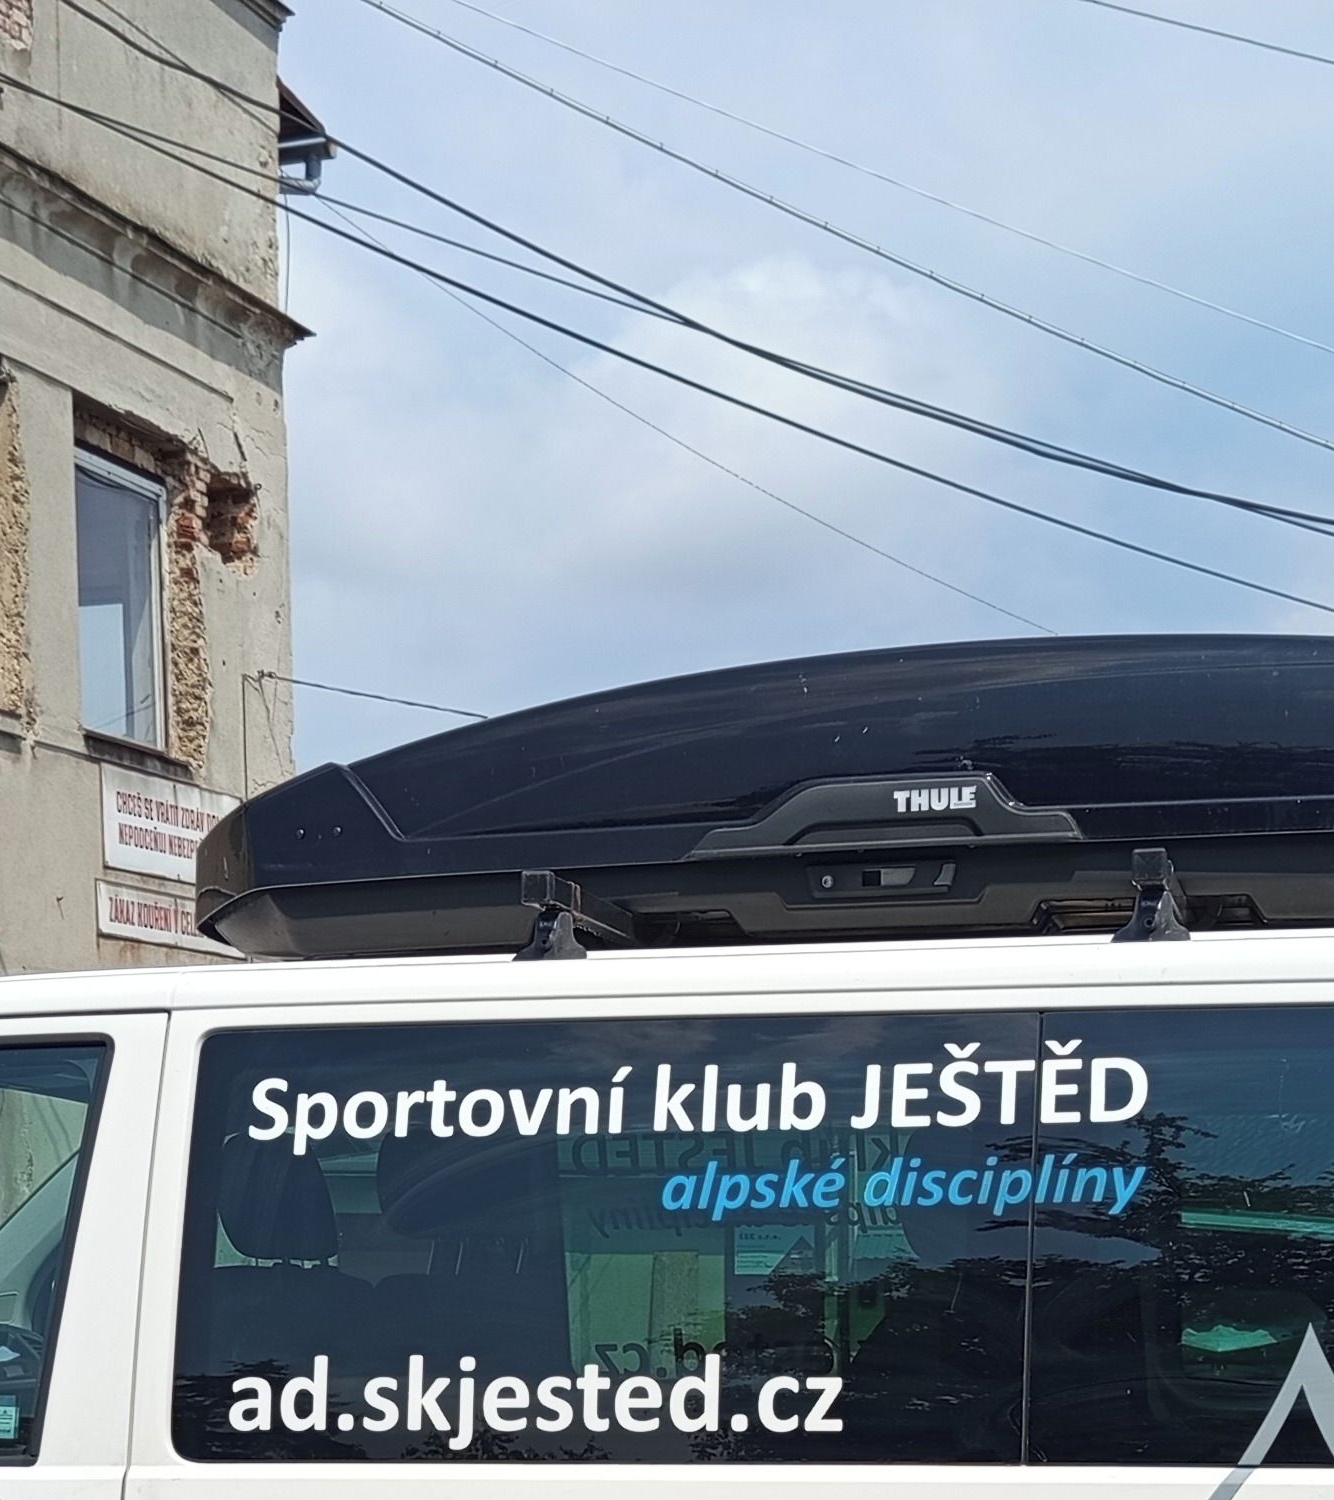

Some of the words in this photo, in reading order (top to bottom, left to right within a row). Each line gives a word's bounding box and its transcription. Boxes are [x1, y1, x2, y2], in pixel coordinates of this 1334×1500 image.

[116, 791, 142, 818] CHCEŠ
[144, 797, 154, 821] SE
[181, 807, 204, 833] ZDRÁV
[893, 785, 977, 813] THULE
[108, 894, 136, 926] ZÁKAZ
[138, 901, 172, 933] KOUŘENÍ
[247, 1064, 626, 1153] Sportovní
[654, 1062, 828, 1133] klub
[850, 1038, 1148, 1128] JEŠTĚD
[662, 1158, 846, 1220] alpské
[862, 1154, 1148, 1214] disciplíny
[229, 1354, 844, 1451] ad.skjested.cz
